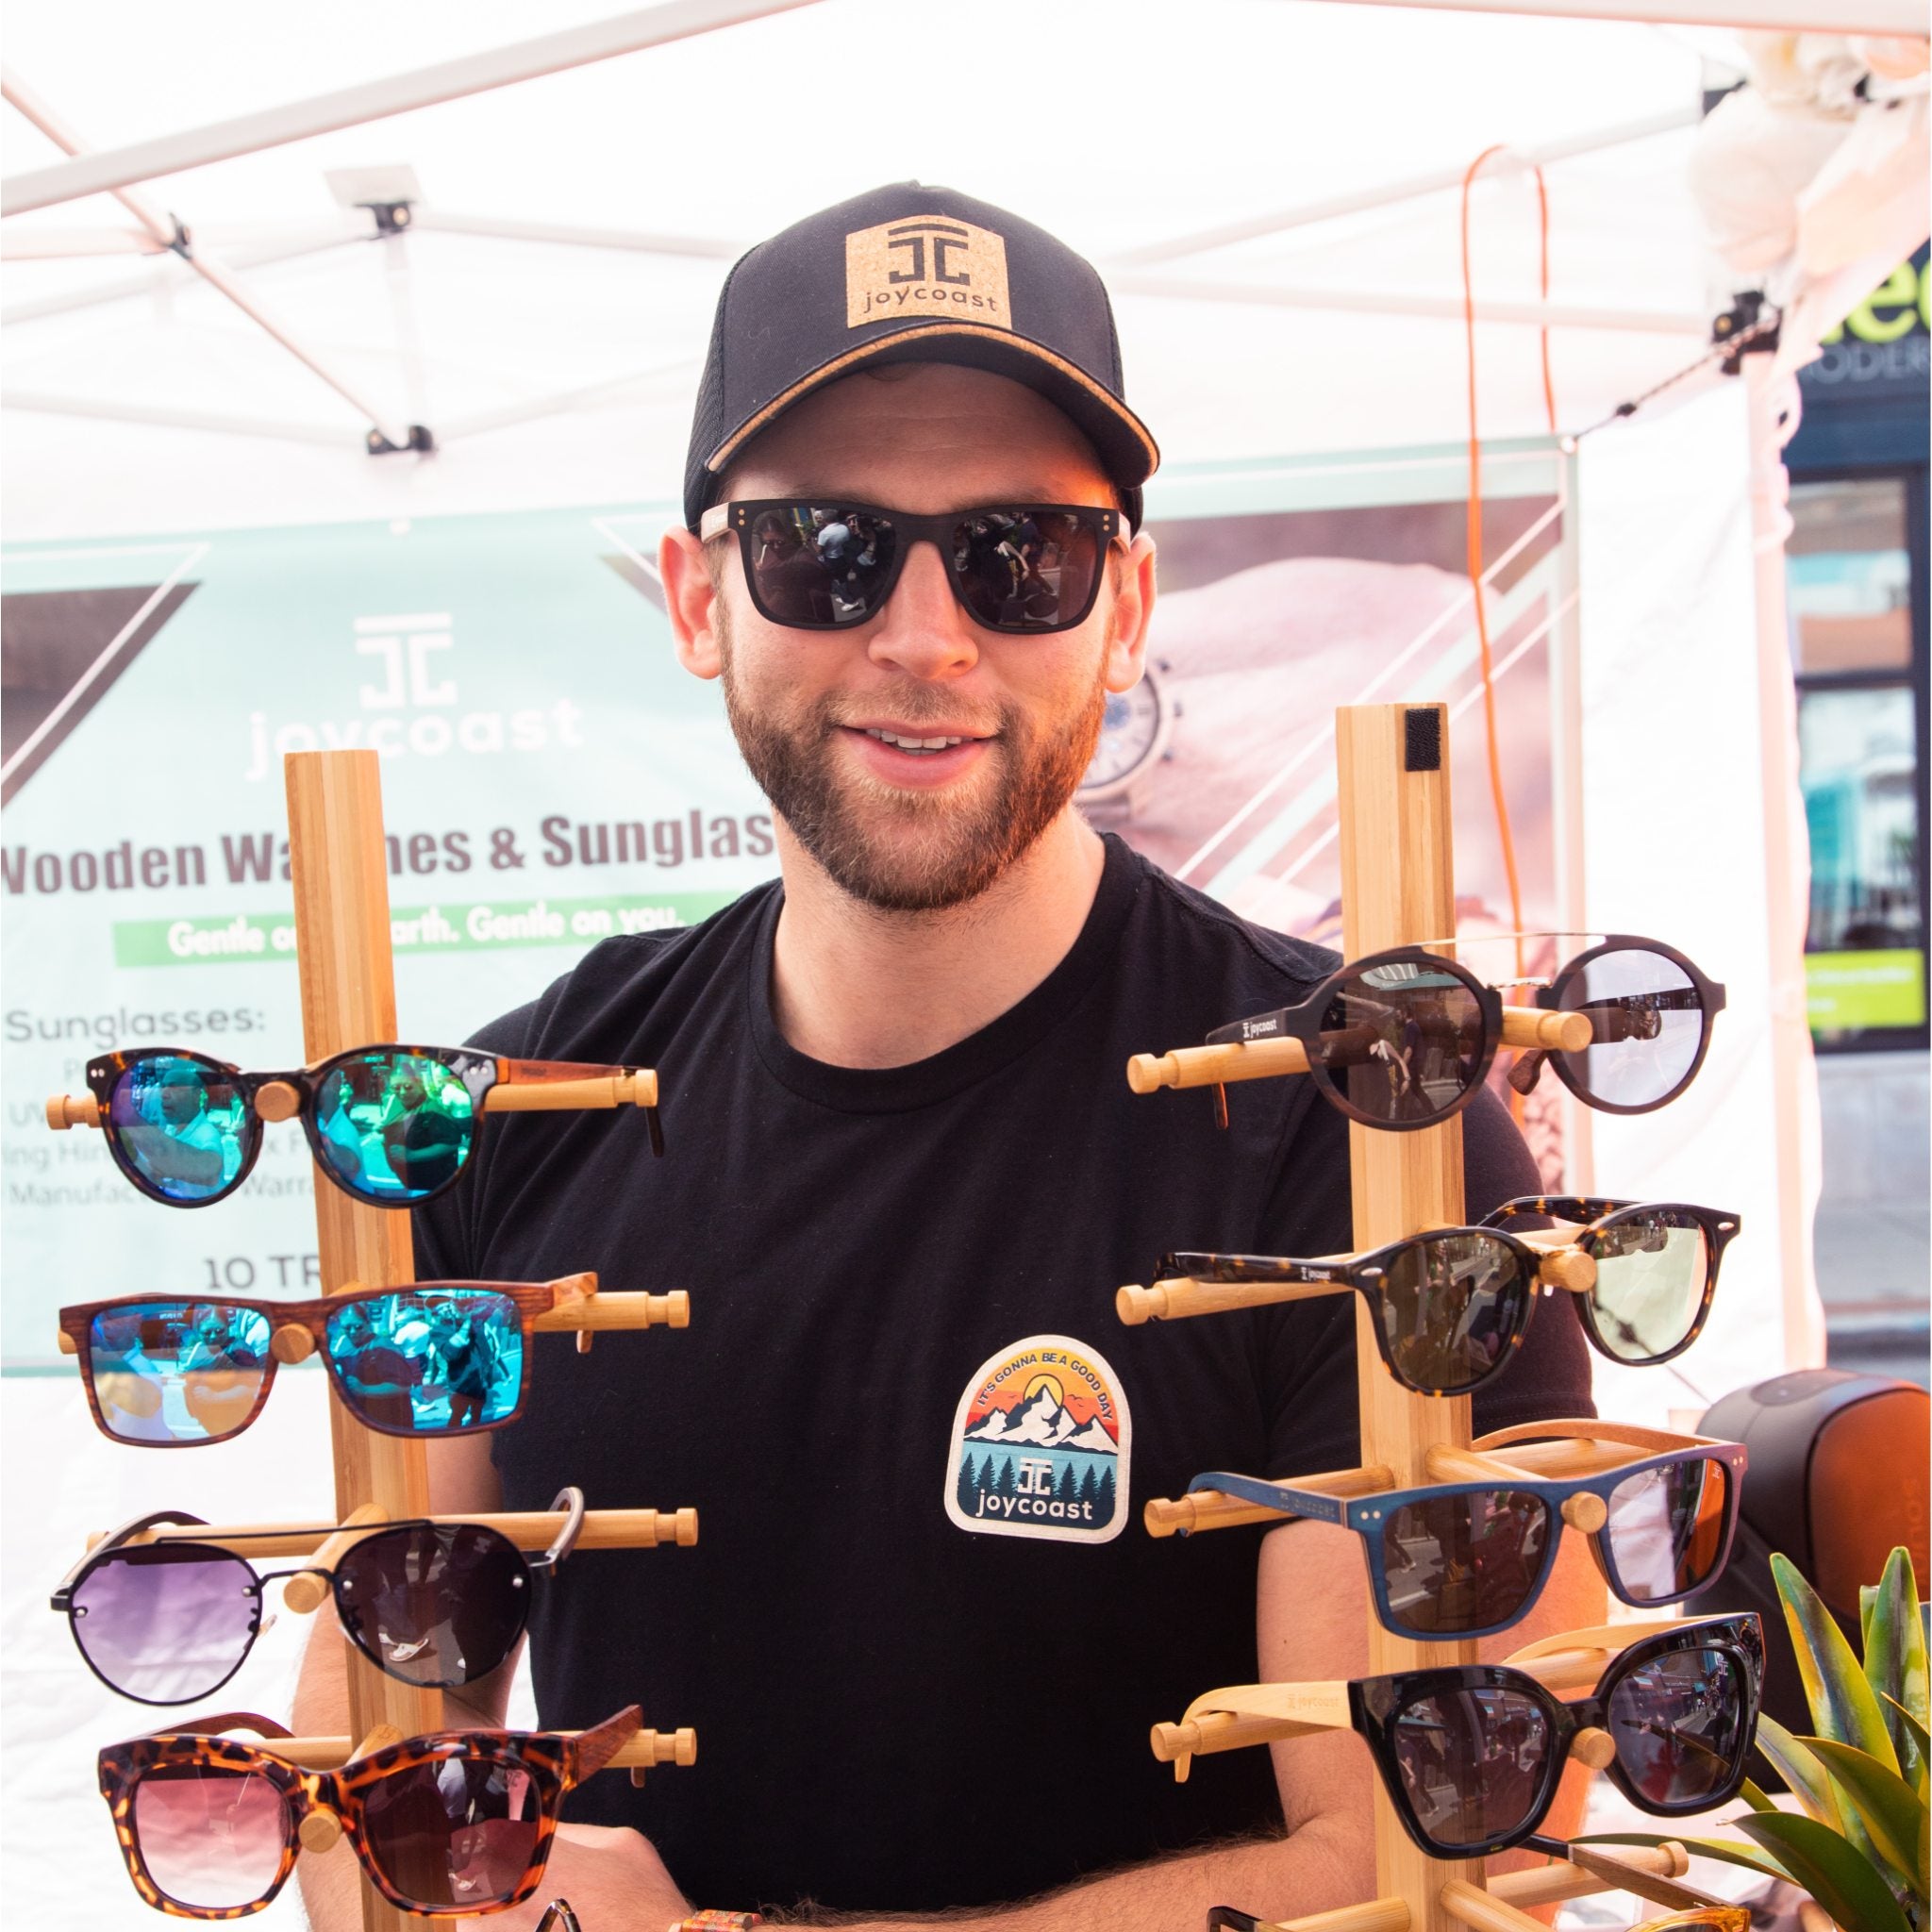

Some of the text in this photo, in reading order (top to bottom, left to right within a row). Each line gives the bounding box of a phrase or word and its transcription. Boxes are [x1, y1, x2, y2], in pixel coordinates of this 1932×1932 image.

[863, 285, 997, 313] joycoast
[244, 696, 585, 783] joycoast
[489, 826, 525, 871] &
[167, 913, 266, 958] Gentle
[390, 905, 460, 945] arth.
[466, 900, 566, 942] Gentle
[571, 910, 611, 937] on
[6, 1006, 266, 1048] Sunglasses:
[205, 1256, 256, 1291] 10
[976, 1352, 1113, 1420] IT'S GONNA BE A GOOD DAY
[975, 1489, 1093, 1521] joycoast
